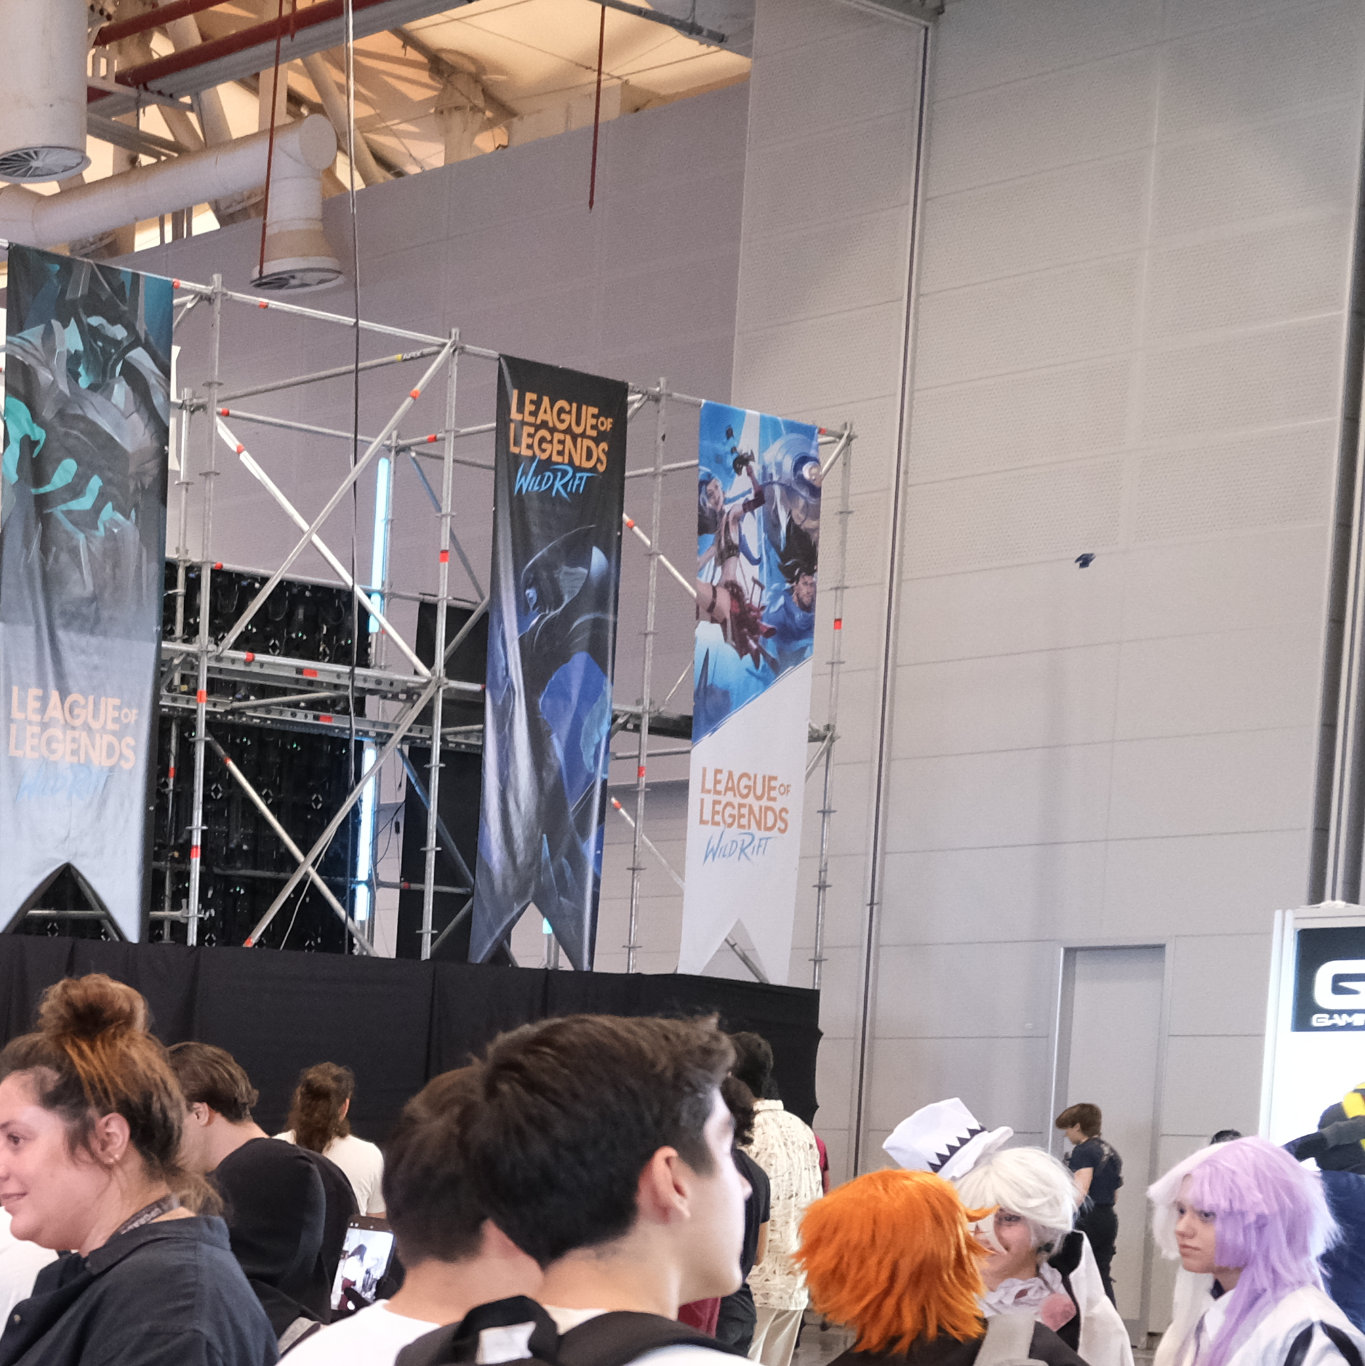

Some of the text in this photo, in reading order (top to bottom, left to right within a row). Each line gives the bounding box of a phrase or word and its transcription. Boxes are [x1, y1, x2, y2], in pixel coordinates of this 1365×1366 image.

[509, 389, 613, 437] LEAGUE OF
[509, 422, 609, 472] LEGENDS
[11, 686, 139, 731] LEAGUE OF
[8, 724, 136, 770] LEGENDS
[700, 767, 791, 802] LEAGUE OF
[699, 798, 789, 834] LEGENDS
